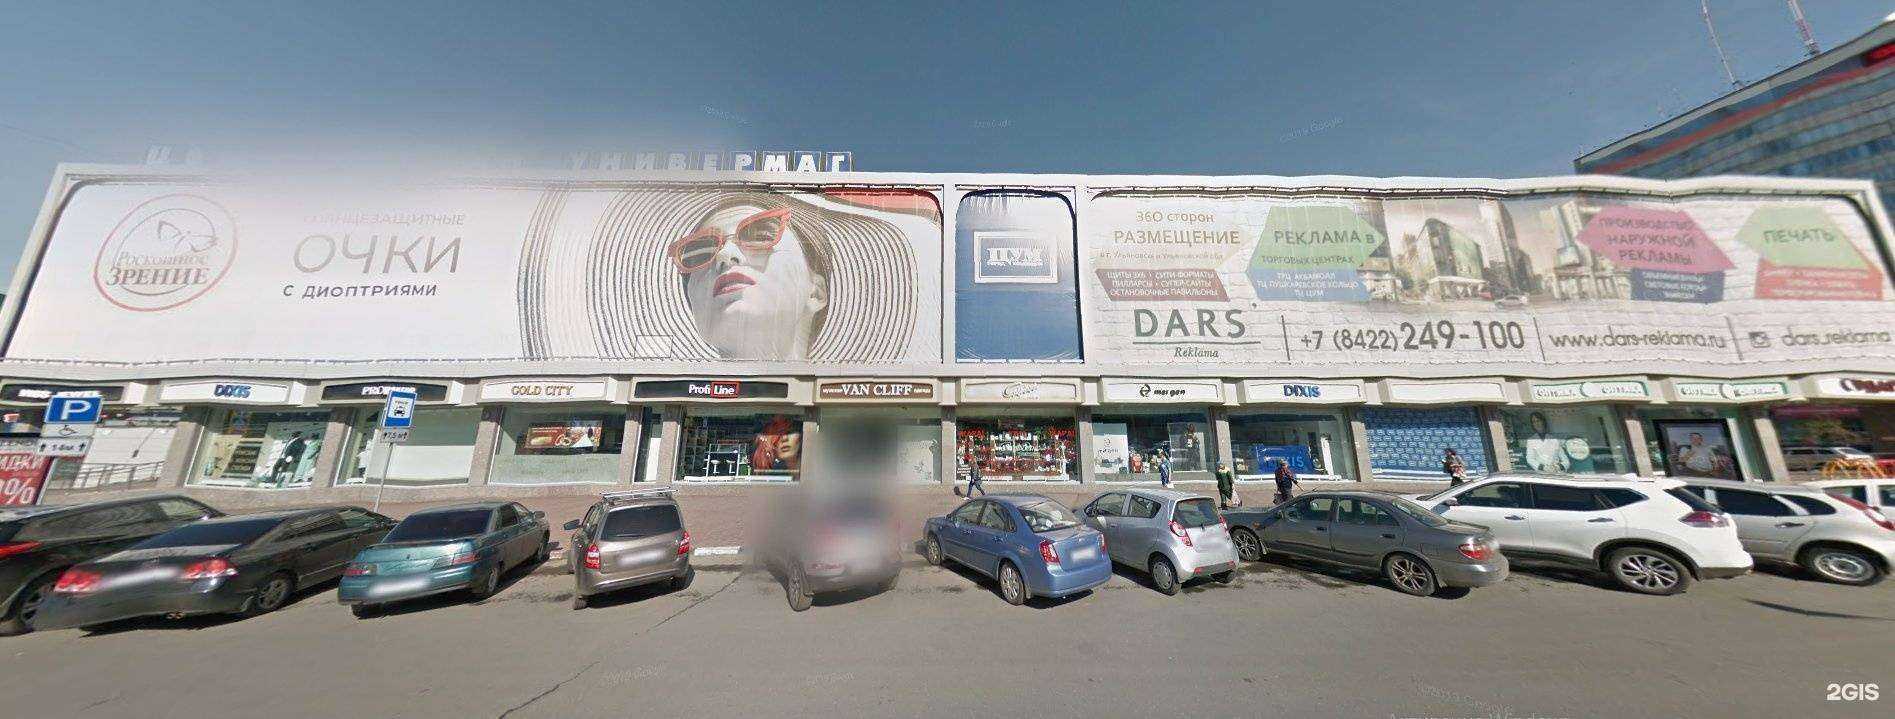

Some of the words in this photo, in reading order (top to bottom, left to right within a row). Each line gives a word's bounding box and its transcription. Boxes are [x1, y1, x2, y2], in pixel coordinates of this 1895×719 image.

[1136, 211, 1163, 223] 360
[1167, 212, 1216, 225] сторон
[1114, 230, 1241, 247] РАЗМЕЩЕНИЕ
[1274, 230, 1362, 245] РЕКЛАМА
[1607, 234, 1695, 247] НАРУЖНОЙ
[1763, 228, 1835, 244] ПЕЧАТЬ
[293, 233, 462, 274] ОЧКИ
[1312, 255, 1354, 266] ЦЕНТРАХ
[1619, 250, 1692, 265] РЕКЛАМЫ
[106, 266, 210, 286] ЗРЕНИЕ
[302, 284, 437, 299] ДИОПТРИЯМИ
[1133, 308, 1246, 339] DARS
[1301, 330, 1324, 350] +7
[1333, 329, 1398, 351] (8422)
[1400, 319, 1525, 350] 249-100
[1550, 325, 1726, 348] www.dars-reklama.ru
[1174, 346, 1220, 358] Reklama
[512, 385, 541, 396] GOLD
[545, 385, 574, 396] CITY
[688, 384, 711, 394] Profi
[714, 384, 735, 395] Line
[841, 384, 870, 396] VAN
[873, 383, 913, 396] CLIFF
[1283, 384, 1321, 398] DIXIS
[61, 399, 92, 421] P
